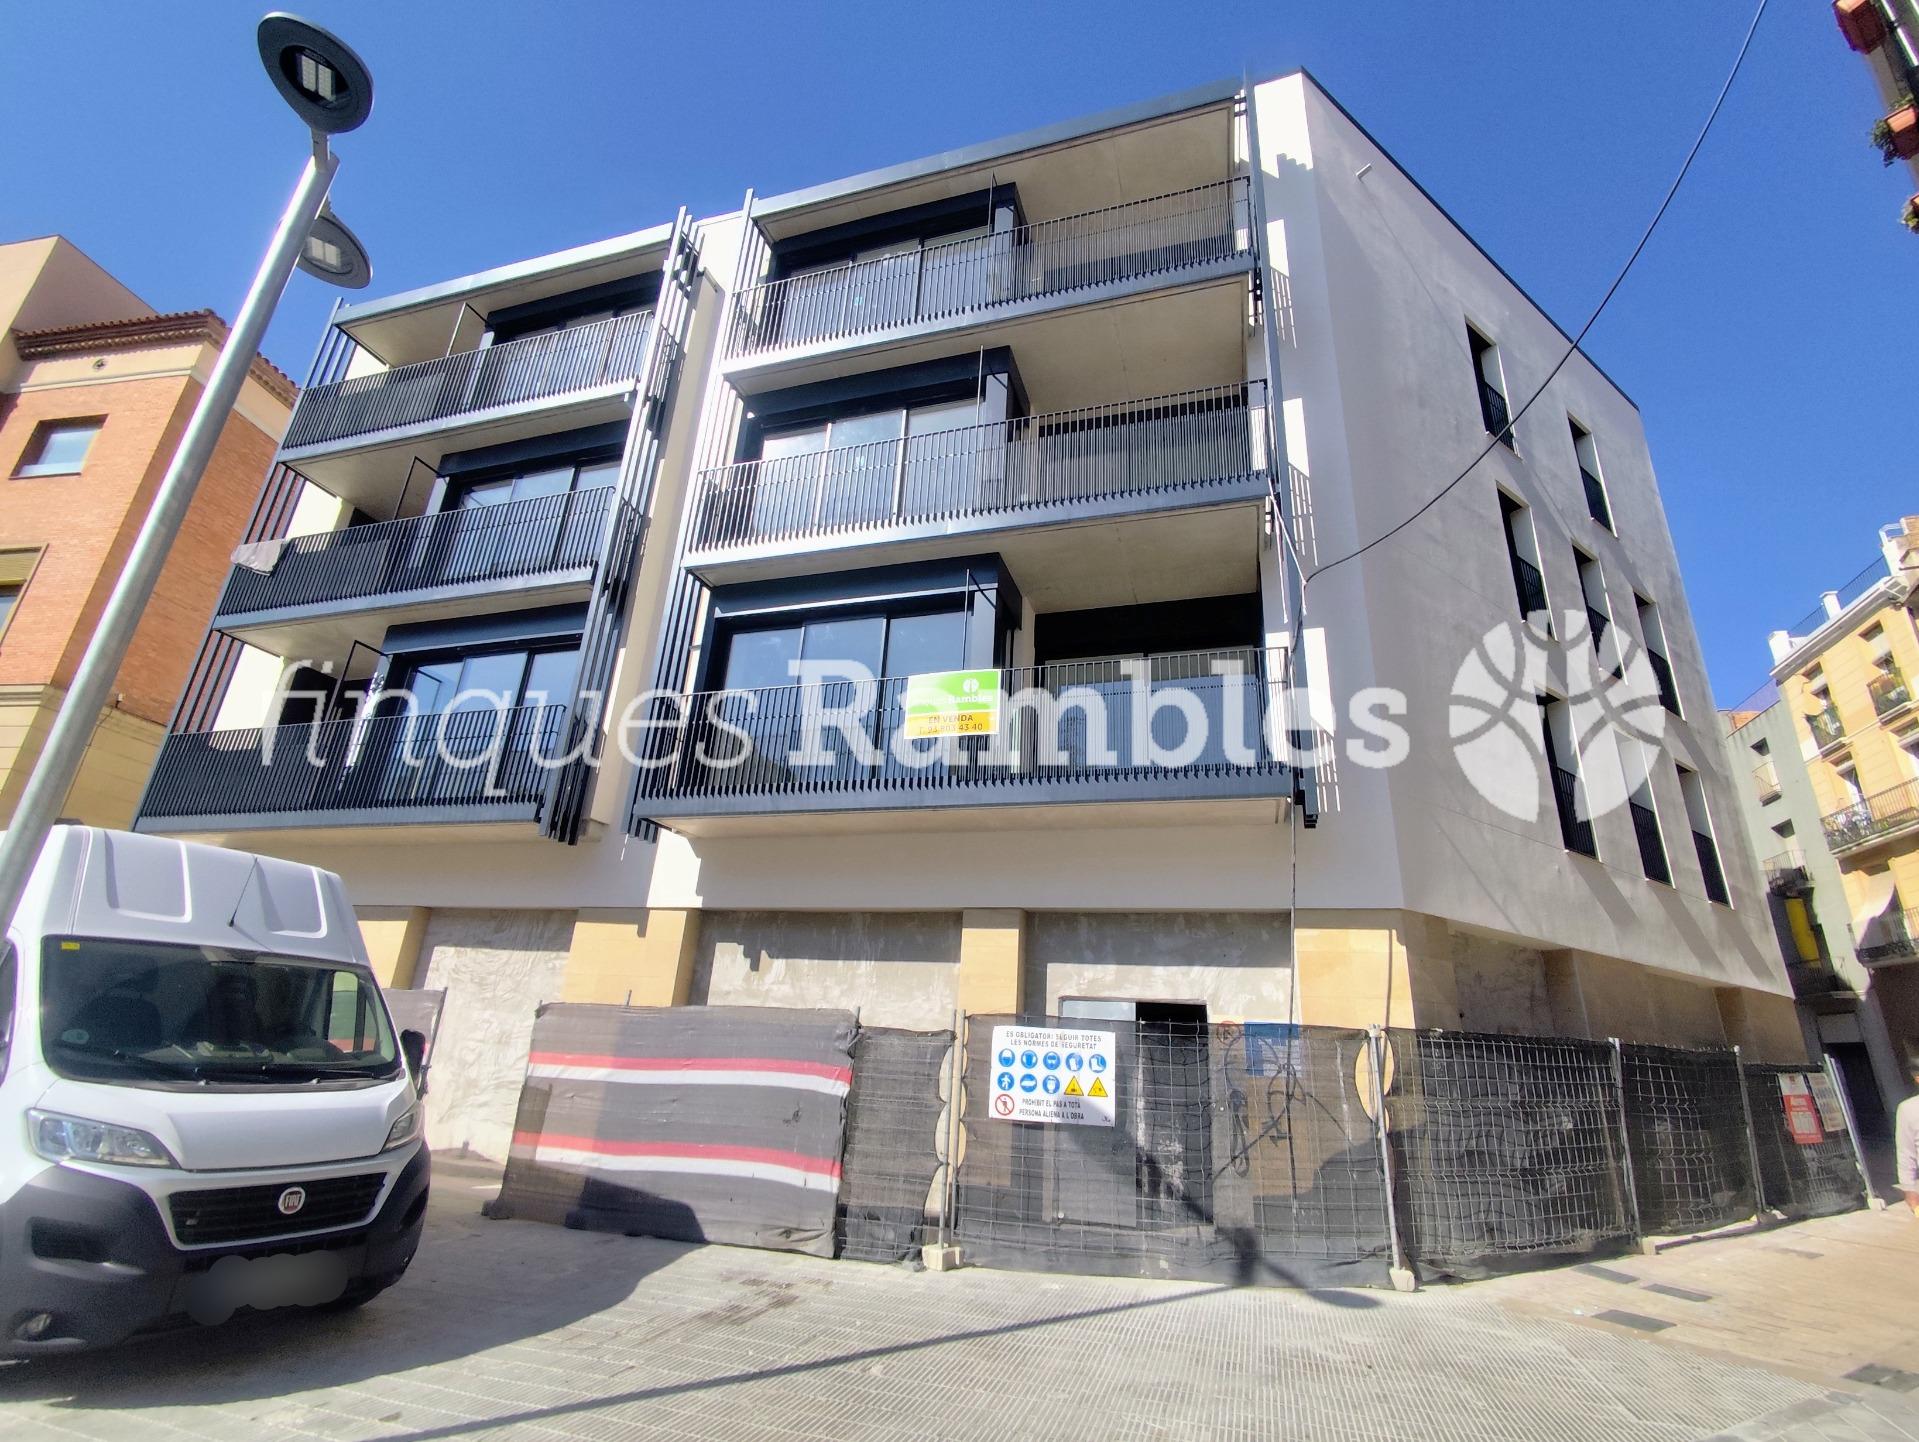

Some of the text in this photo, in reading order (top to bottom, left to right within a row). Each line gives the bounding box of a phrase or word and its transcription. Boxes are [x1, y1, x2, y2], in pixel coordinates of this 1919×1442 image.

[943, 714, 974, 723] VENDA
[959, 723, 970, 731] 43
[972, 722, 983, 731] 40
[1081, 1034, 1102, 1042] TOTES
[1010, 1038, 1097, 1050] LES NORMES DE SEGURETAT
[1022, 1098, 1045, 1107] PROHIBIT
[1045, 1099, 1052, 1107] EL
[1053, 1100, 1063, 1108] PAS
[1019, 1108, 1042, 1117] PERSONA
[1042, 1109, 1061, 1118] ALIENA
